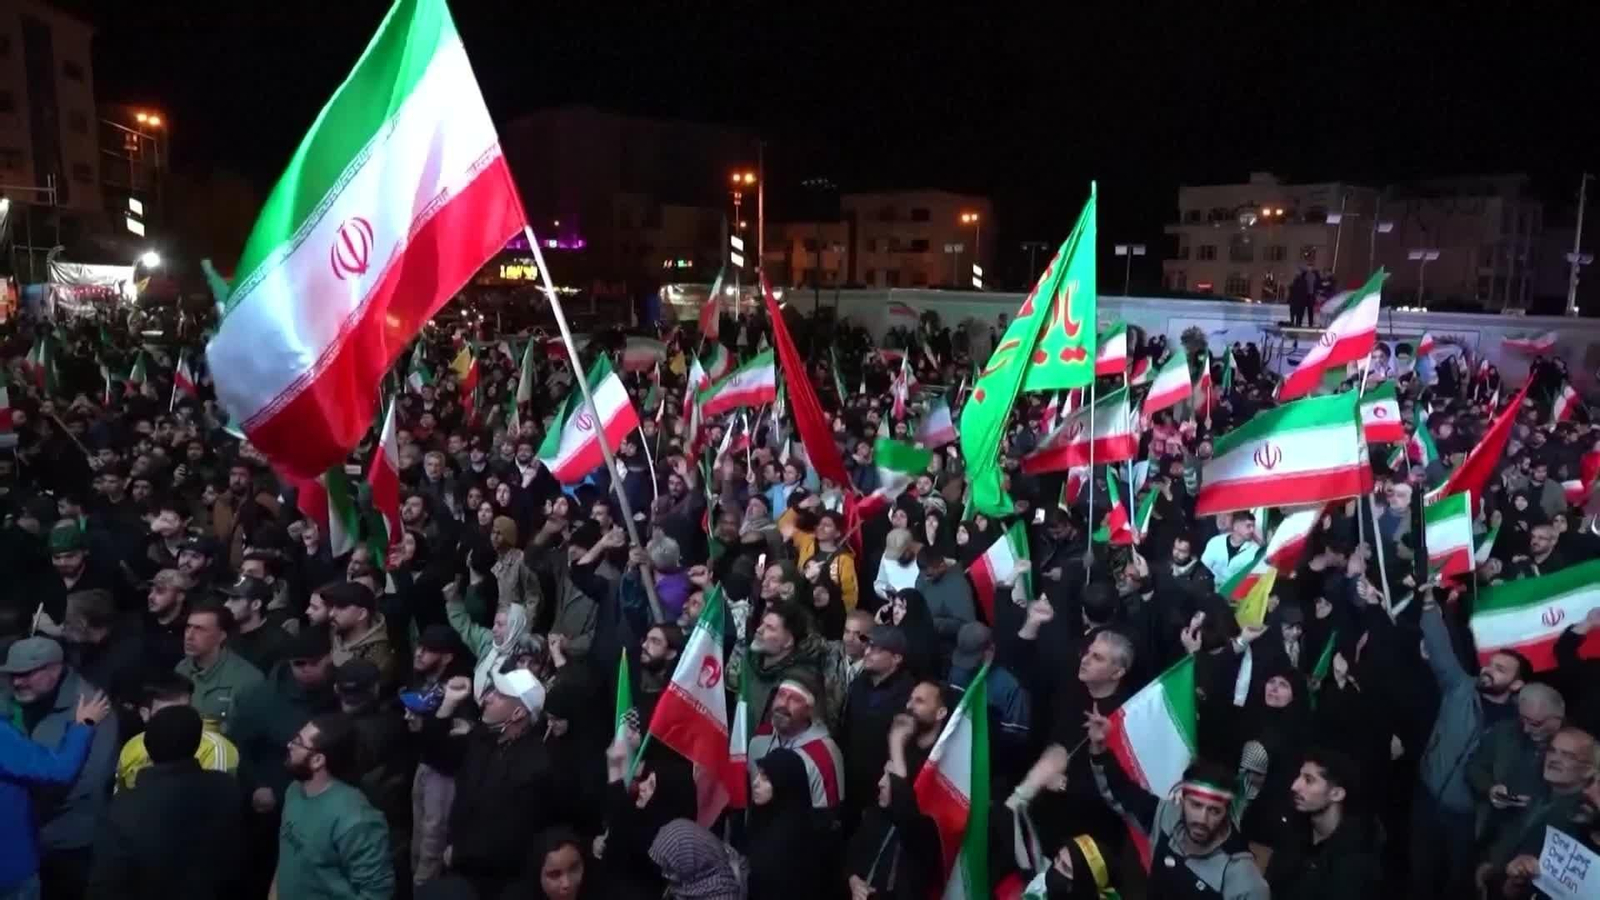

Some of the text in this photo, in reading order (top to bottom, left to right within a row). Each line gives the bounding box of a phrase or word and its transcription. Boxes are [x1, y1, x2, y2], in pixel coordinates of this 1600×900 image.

[1552, 832, 1570, 851] One
[1549, 846, 1564, 864] One
[1543, 858, 1559, 877] One
